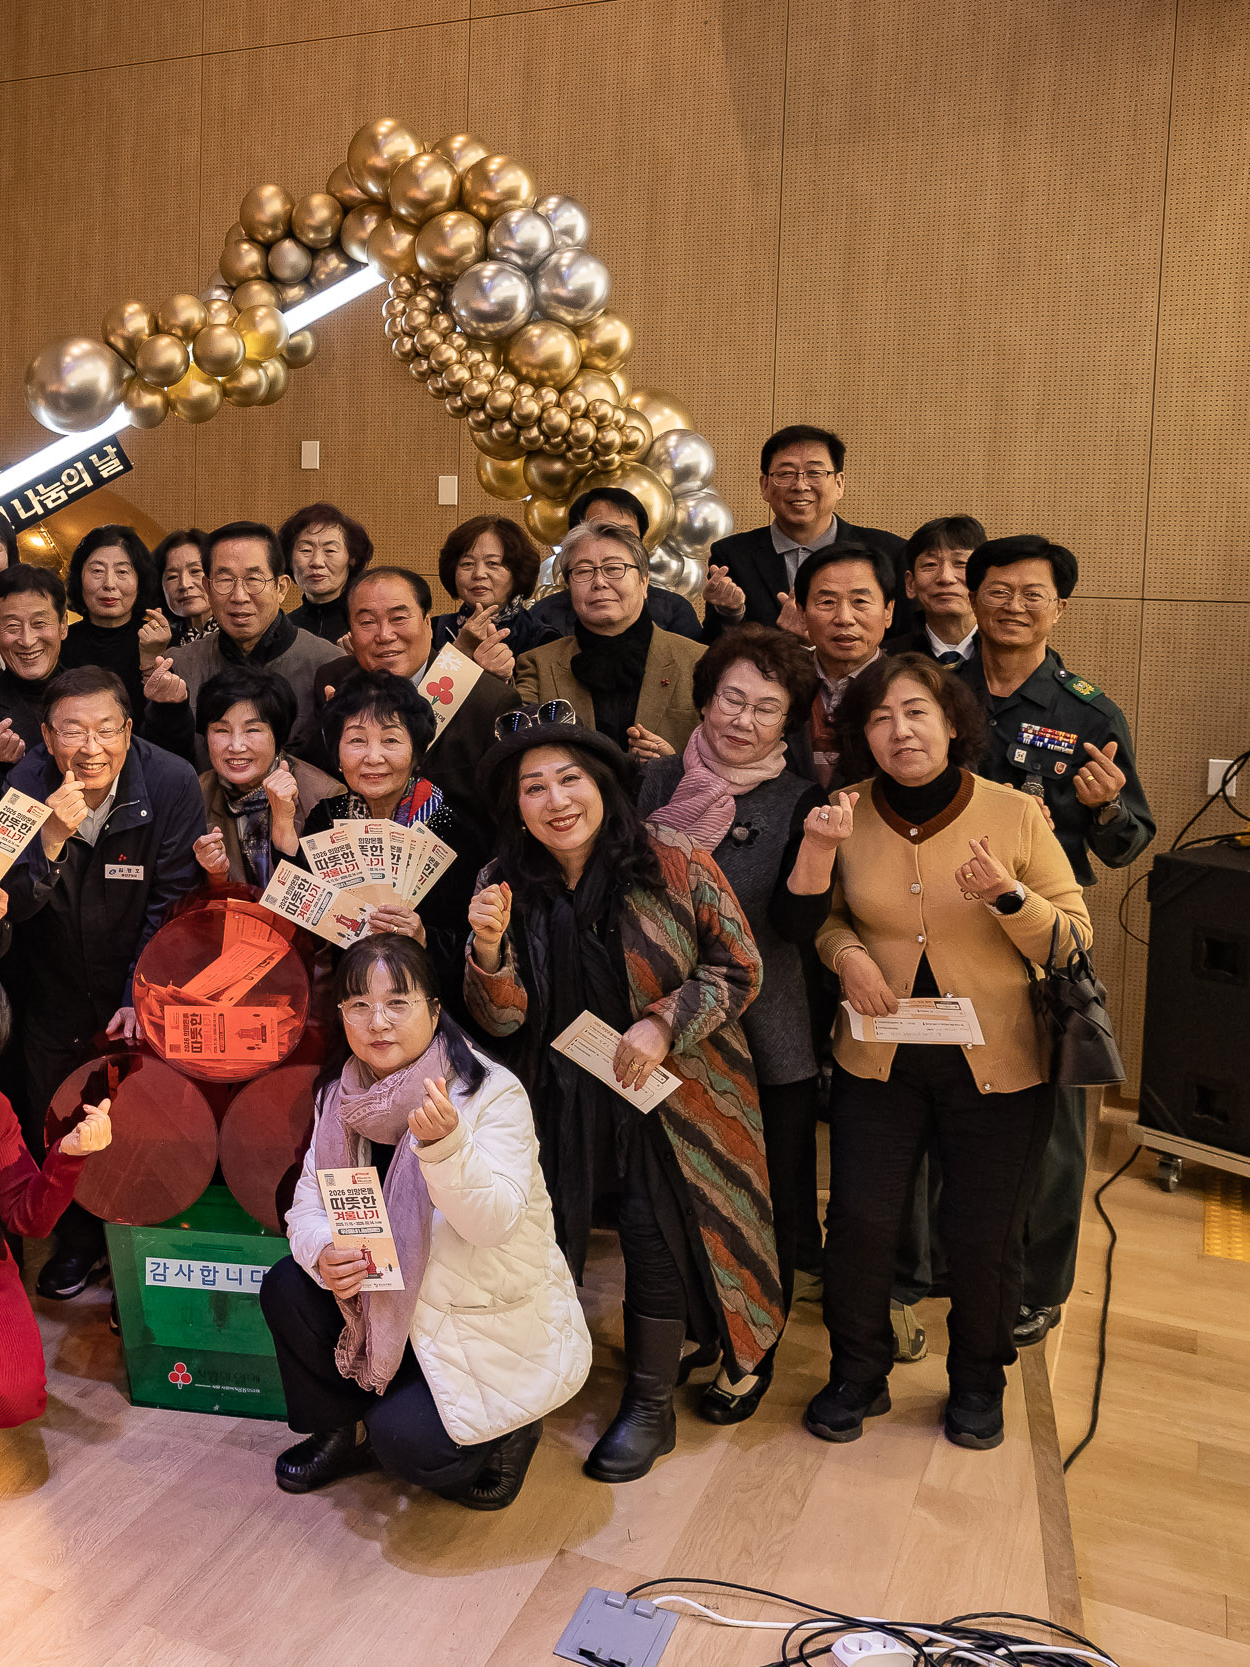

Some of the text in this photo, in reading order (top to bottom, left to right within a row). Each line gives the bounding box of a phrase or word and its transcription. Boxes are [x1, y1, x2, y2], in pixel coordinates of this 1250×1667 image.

[10, 462, 93, 520] 나눔의
[88, 444, 124, 479] 날
[358, 844, 384, 857] 뜻한
[314, 850, 357, 871] 따뜻한
[319, 862, 360, 880] 겨울나기
[285, 877, 312, 916] 따뜻한
[190, 1012, 203, 1053] 따뜻한
[329, 1195, 377, 1210] 따뜻한
[333, 1209, 380, 1221] 겨울나기
